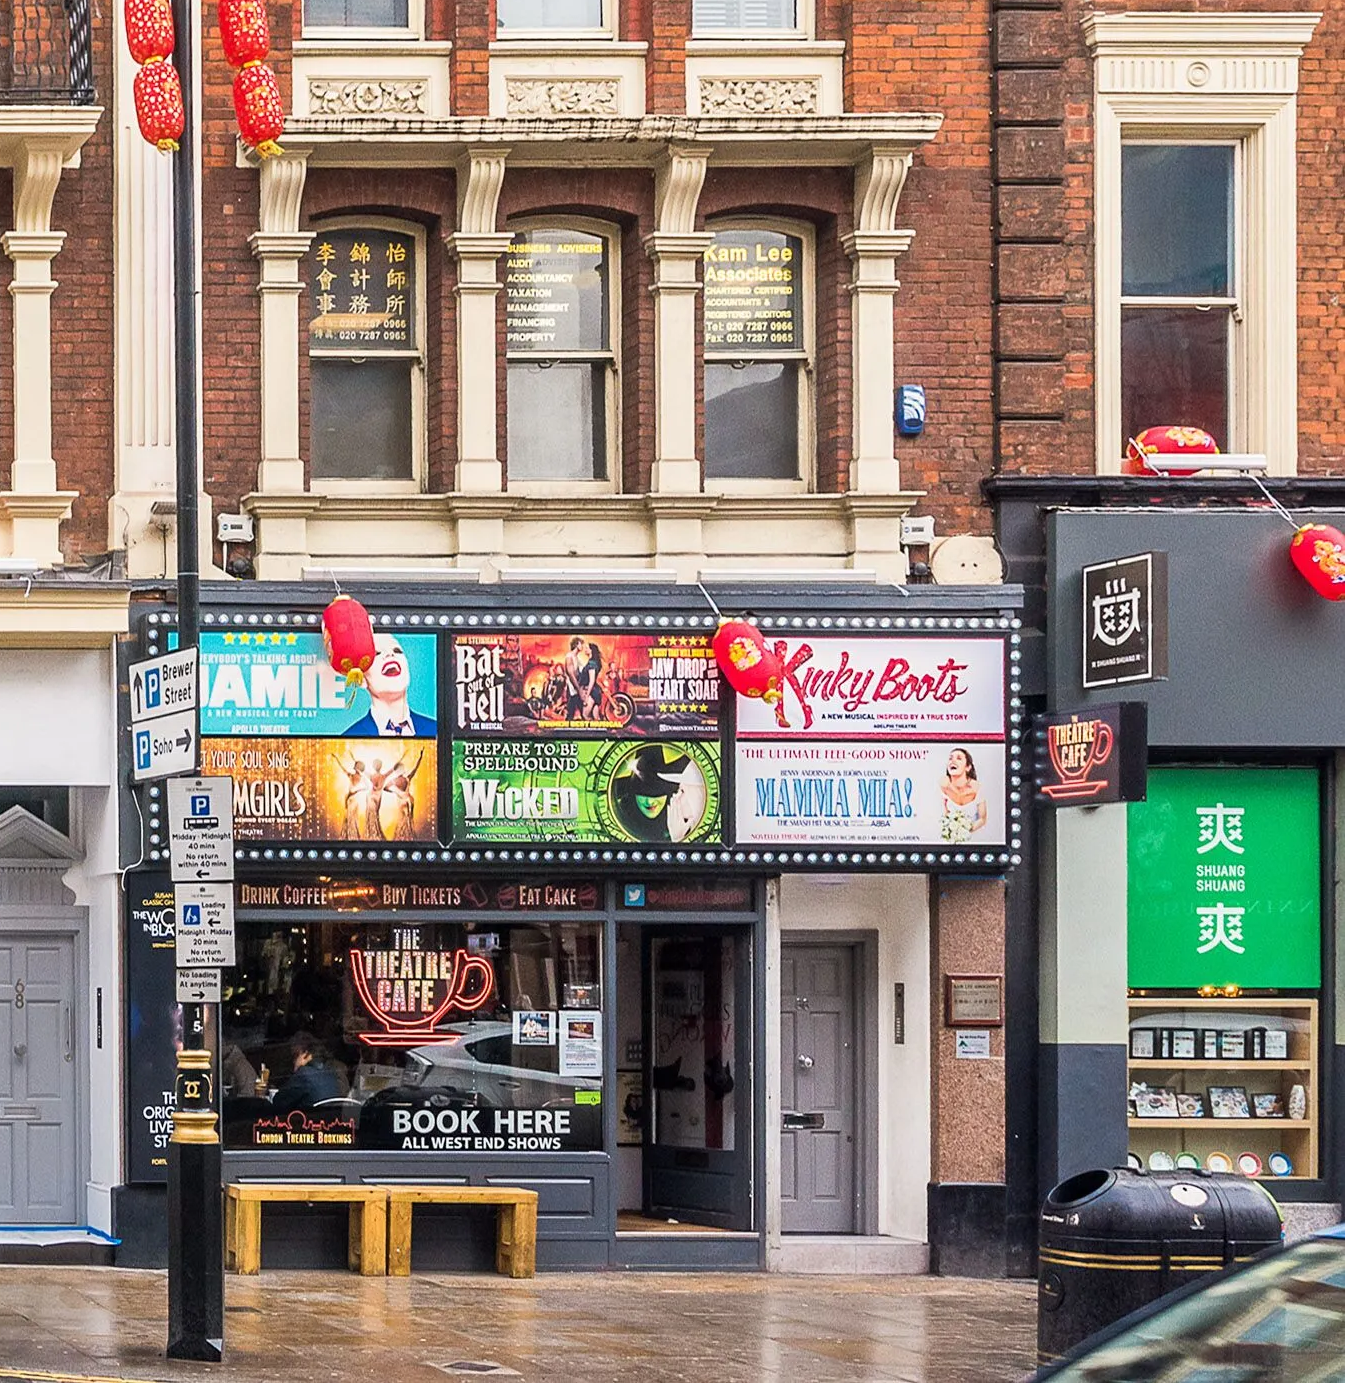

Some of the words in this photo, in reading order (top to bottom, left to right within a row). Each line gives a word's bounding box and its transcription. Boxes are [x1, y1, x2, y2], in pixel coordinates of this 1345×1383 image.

[252, 654, 286, 664] TALKING
[289, 654, 317, 664] ABOUT
[455, 645, 505, 683] Bat
[649, 658, 673, 679] JAW
[676, 658, 705, 679] DROP
[162, 661, 194, 681] Brewer
[165, 682, 192, 705] Street
[649, 680, 685, 700] HEART
[774, 640, 874, 729] Kinky
[872, 658, 968, 703] Boots
[456, 683, 504, 729] Hell
[877, 713, 908, 721] INSPIRED
[231, 725, 258, 733] APOLLO
[1055, 720, 1095, 747] THEATRE
[153, 738, 173, 756] Soho
[465, 743, 530, 755] PREPARE
[534, 743, 555, 756] TO
[560, 743, 578, 755] BE
[769, 749, 819, 760] ULTIMATE
[1060, 743, 1087, 769] CAFE
[210, 751, 236, 768] YOUR
[241, 751, 263, 768] SOUL
[267, 751, 289, 768] SING
[464, 757, 579, 771] SPELLBOUND
[755, 778, 850, 817] MAMMA
[857, 777, 913, 818] MIA!
[172, 833, 196, 841] Midday
[201, 832, 231, 841] Midnight
[1196, 803, 1245, 854] 爽
[1196, 865, 1245, 877] SHUANG
[242, 884, 279, 905] DRINK
[283, 884, 327, 905] COFFEE
[382, 885, 408, 905] BUY
[410, 884, 461, 905] TICKETS
[519, 885, 542, 905] EAT
[545, 885, 577, 906] CAKE
[1196, 879, 1245, 892] SHUANG
[210, 928, 232, 936] Midday
[1196, 902, 1245, 954] 爽
[394, 928, 420, 950] THE
[363, 950, 452, 979] THEATRE
[179, 980, 188, 988] At
[190, 981, 218, 989] anytime
[192, 971, 217, 979] loading
[376, 980, 435, 1012] CAFE
[149, 1120, 174, 1134] LIVE
[393, 1109, 481, 1134] BOOK
[494, 1109, 571, 1134] HERE
[256, 1130, 284, 1143] LONDON
[286, 1131, 315, 1144] THEATRE
[317, 1131, 352, 1144] BOOKINGS
[401, 1136, 429, 1149] ALL
[432, 1136, 472, 1150] WEST
[474, 1136, 505, 1150] END
[507, 1136, 562, 1150] SHOWS
